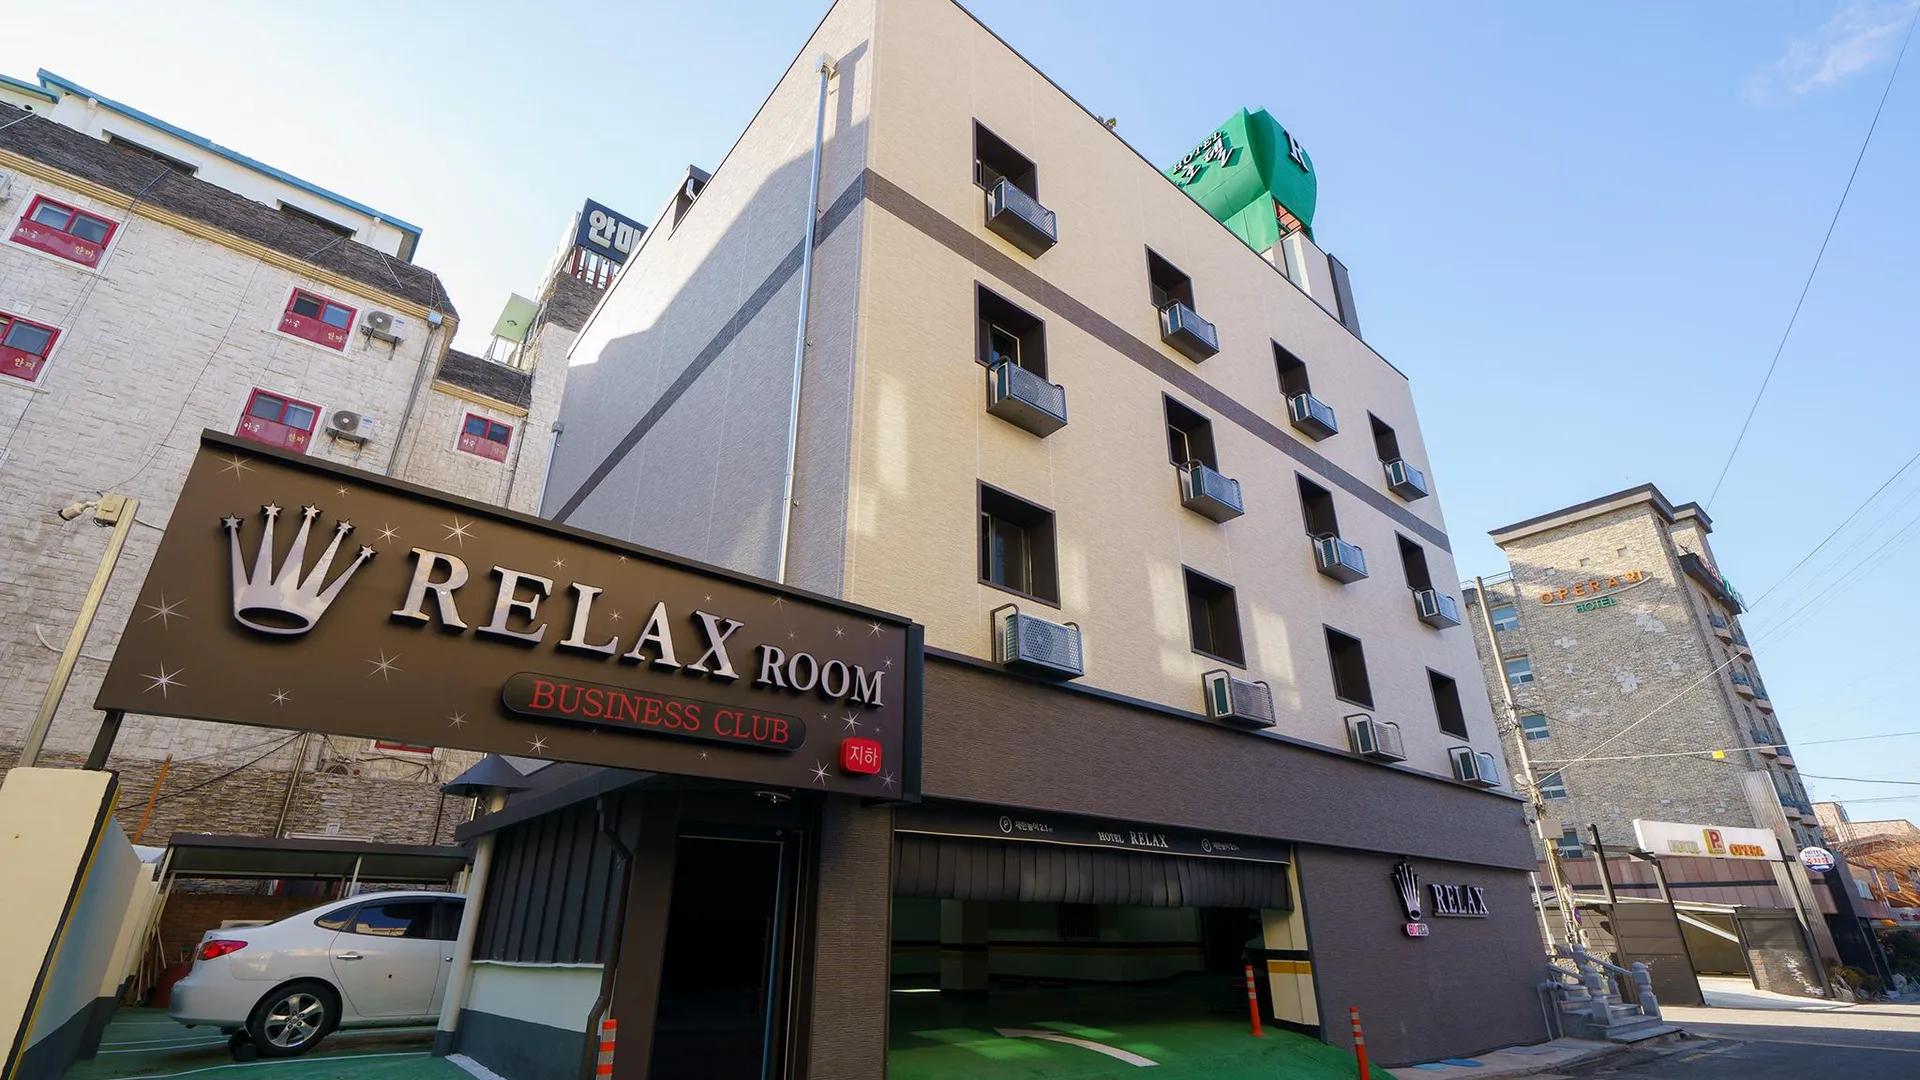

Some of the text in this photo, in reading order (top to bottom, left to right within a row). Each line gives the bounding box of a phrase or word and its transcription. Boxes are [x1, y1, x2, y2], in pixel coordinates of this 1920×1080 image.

[1173, 131, 1221, 174] HOTEL
[14, 356, 36, 371] 안마
[1539, 570, 1643, 604] OPERA 21
[1575, 597, 1618, 613] HOTEL
[390, 547, 886, 707] RELAX ROOM
[528, 679, 790, 744] BUSINESS CLUB
[848, 744, 879, 769] 지하
[1098, 830, 1169, 849] HOTEL RELAX
[1729, 844, 1766, 857] OPERA
[1432, 884, 1489, 914] RELAX
